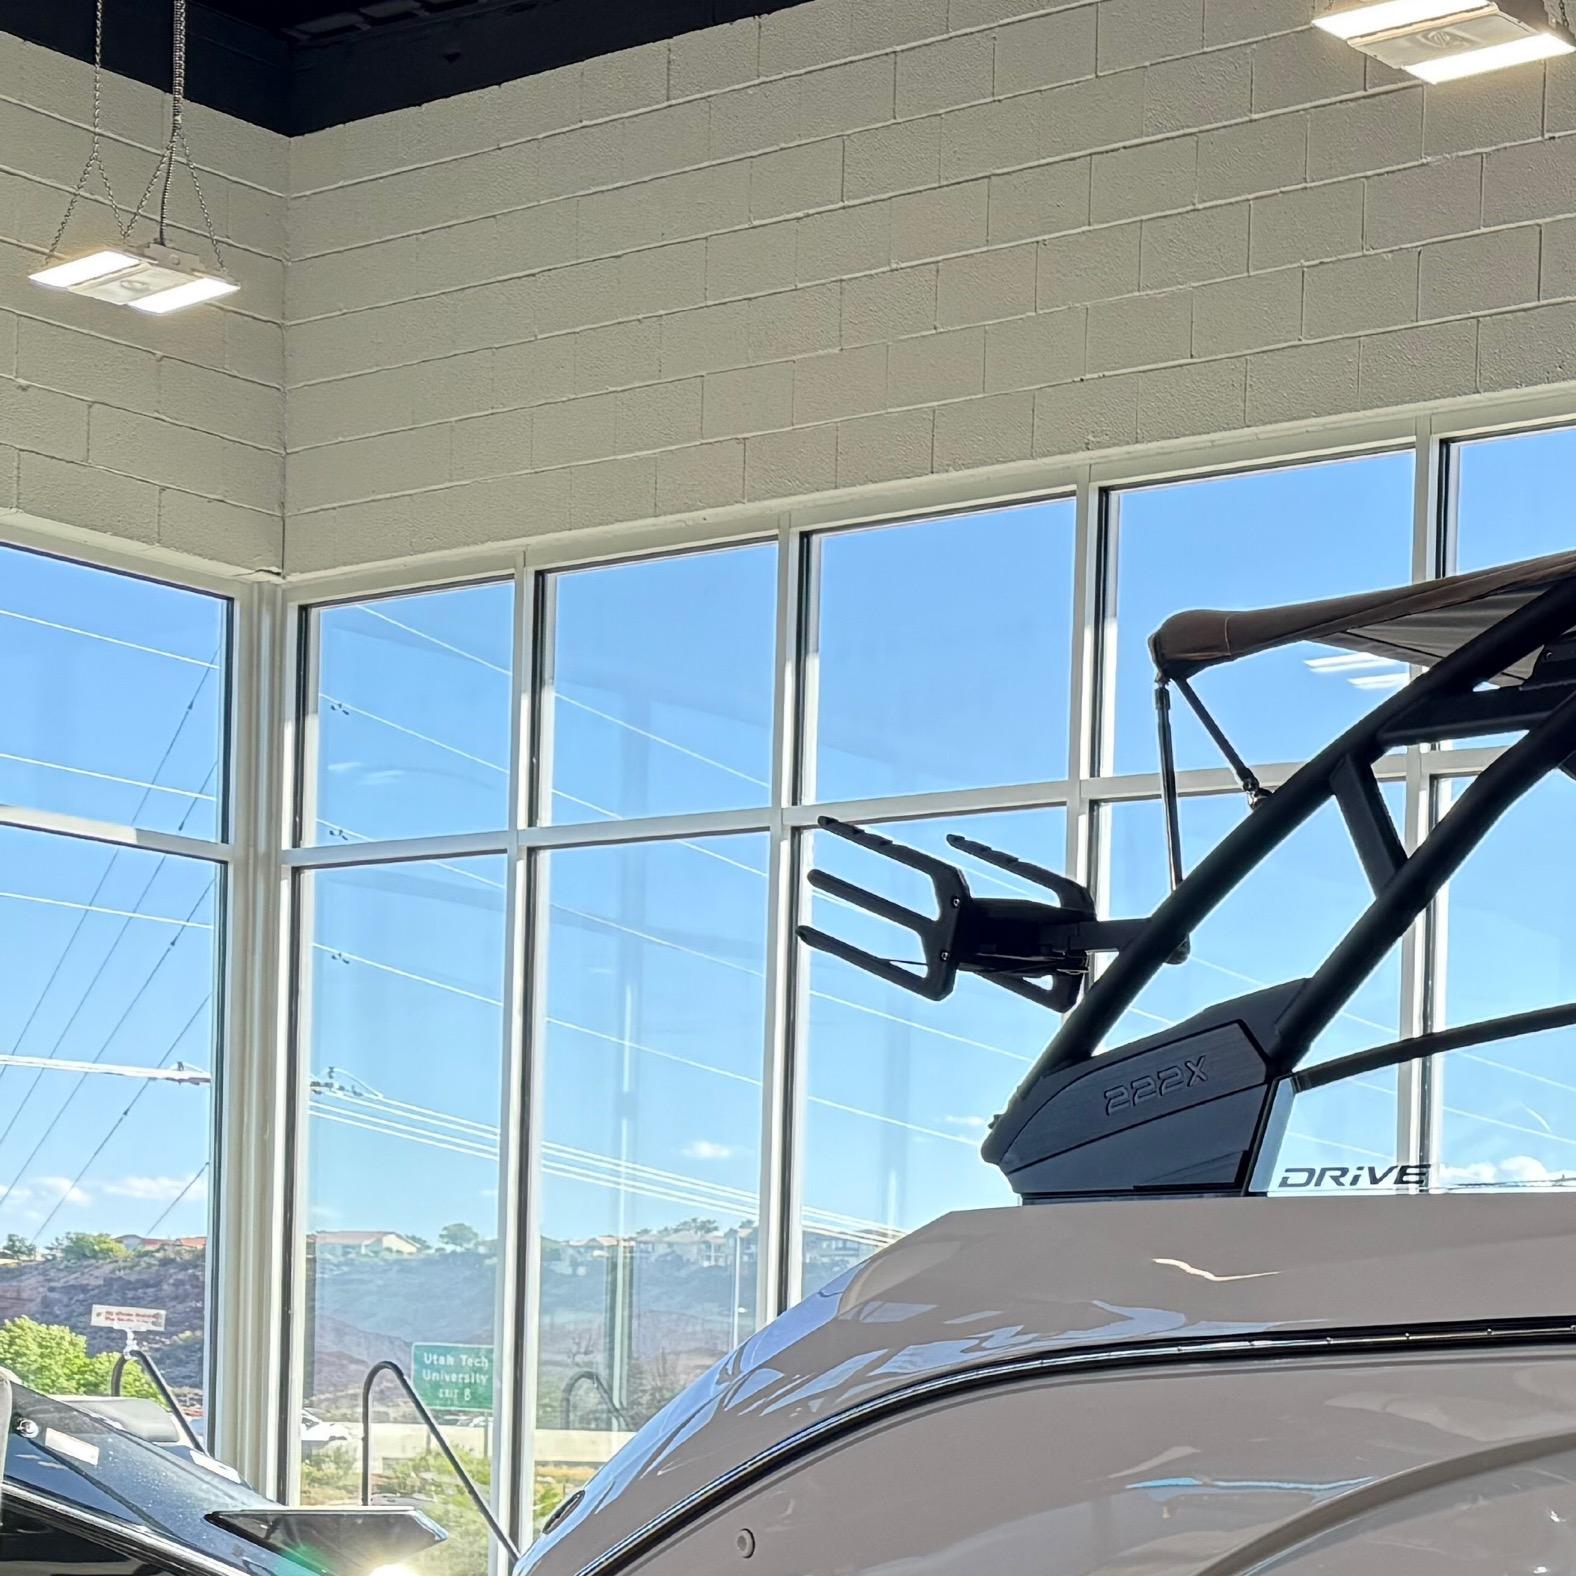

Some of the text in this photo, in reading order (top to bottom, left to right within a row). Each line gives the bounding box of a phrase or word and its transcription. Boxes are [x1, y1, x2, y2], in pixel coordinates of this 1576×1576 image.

[1103, 1055, 1208, 1116] 222X
[424, 1352, 489, 1370] Utah Tech
[422, 1369, 489, 1385] University
